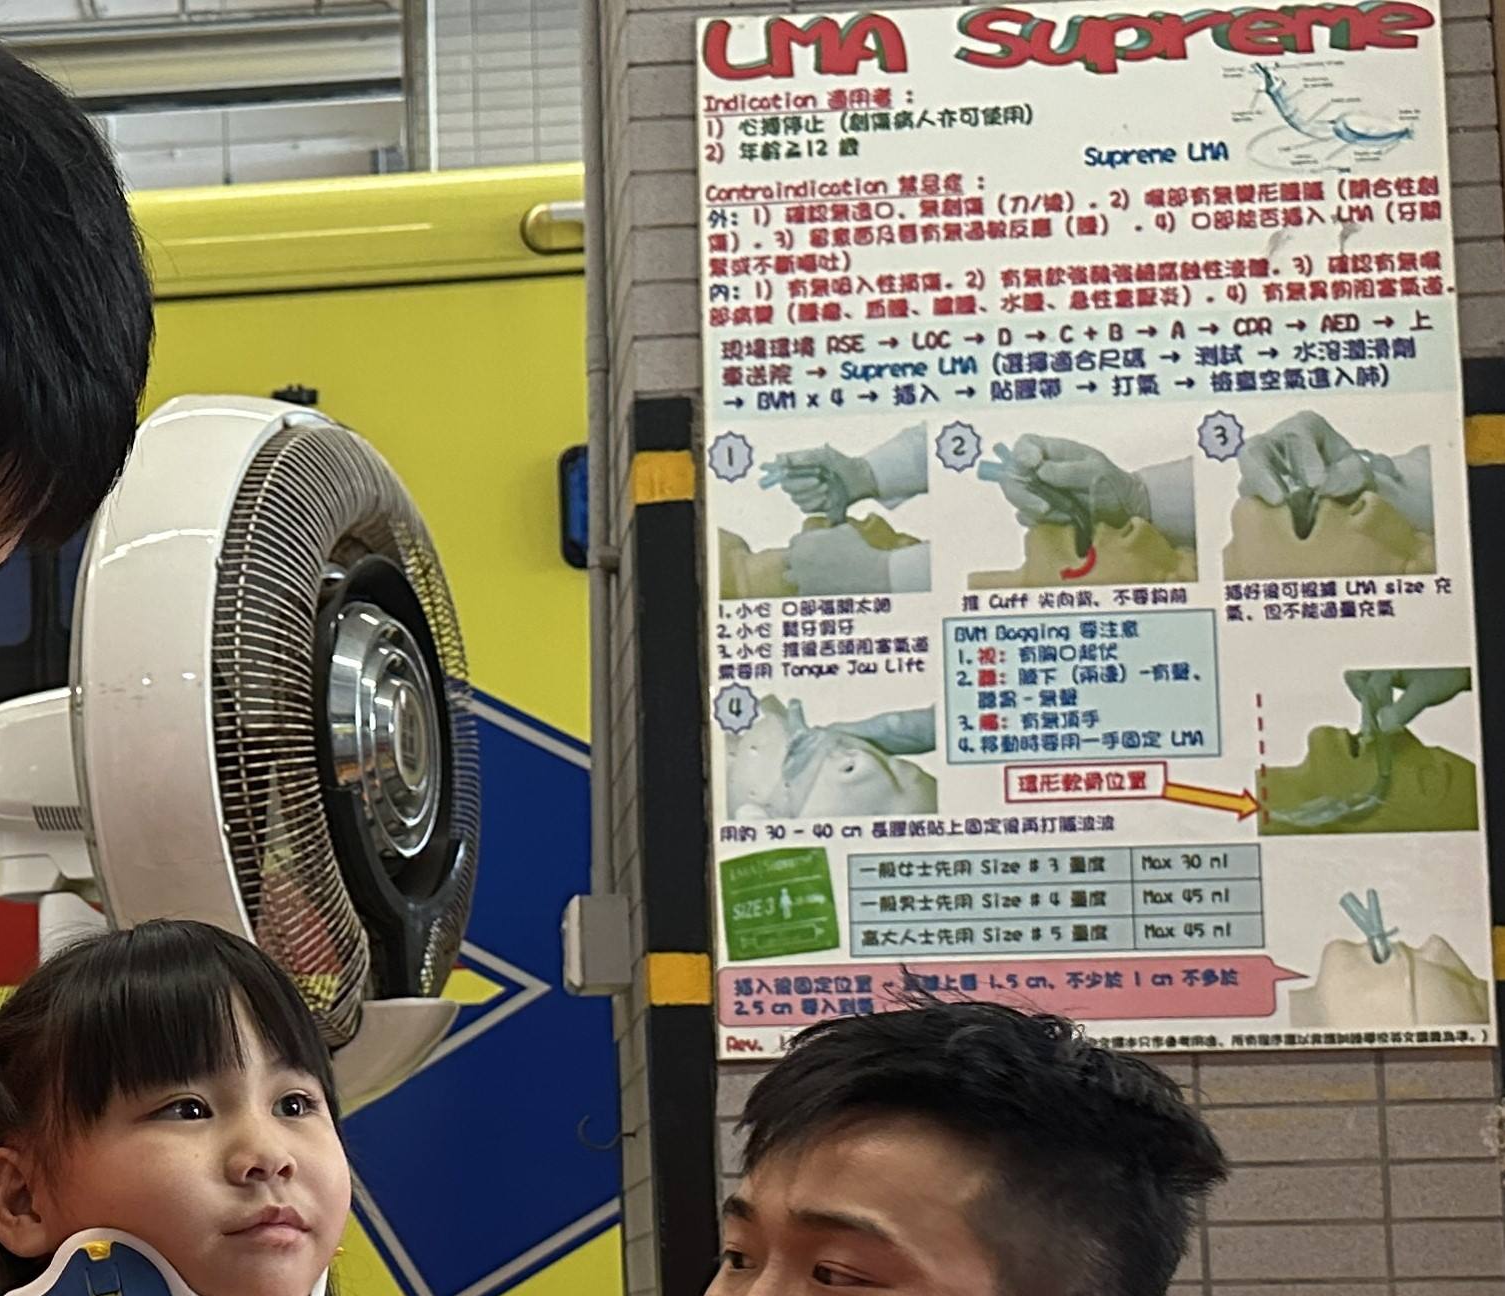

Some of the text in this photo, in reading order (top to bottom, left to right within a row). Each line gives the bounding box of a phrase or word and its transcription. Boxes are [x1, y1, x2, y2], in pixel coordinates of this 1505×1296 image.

[702, 1, 1435, 80] LMA Supreme
[704, 92, 817, 113] Indication
[705, 115, 727, 139] 1)
[705, 143, 724, 164] 2)
[1085, 142, 1229, 168] Supreme LMA
[706, 178, 888, 202] Contraindication
[1333, 205, 1374, 226] LMA
[912, 330, 951, 350] LOC
[998, 328, 1012, 346] D
[1060, 325, 1074, 344] C
[1109, 323, 1123, 342] B
[1171, 321, 1185, 339] A
[1321, 313, 1360, 333] AED
[1410, 310, 1433, 331] 上
[841, 361, 928, 382] Supreme
[939, 356, 978, 375] LMA
[758, 391, 796, 410] BVM
[831, 388, 844, 407] 4
[1214, 425, 1229, 446] 3
[952, 436, 966, 456] 2
[1346, 580, 1376, 595] LMA
[1386, 579, 1424, 594] size
[989, 593, 1028, 609] Cuff
[955, 627, 987, 642] BVM
[996, 624, 1070, 642] Bagging
[885, 658, 924, 673] Lift
[729, 698, 742, 717] 4
[1171, 730, 1204, 746] LMA
[766, 825, 786, 839] 30
[813, 823, 833, 838] 40
[981, 859, 1020, 874] Size
[1142, 856, 1172, 870] Max
[1181, 854, 1202, 869] 30
[982, 893, 1022, 908] Size
[1050, 892, 1060, 906] 4
[1143, 890, 1173, 904] Max
[1182, 888, 1203, 903] 45
[984, 927, 1023, 943] Size
[1051, 926, 1062, 941] 5
[1145, 924, 1175, 939] Max
[1184, 923, 1205, 937] 45
[725, 1035, 764, 1052] Rev.
